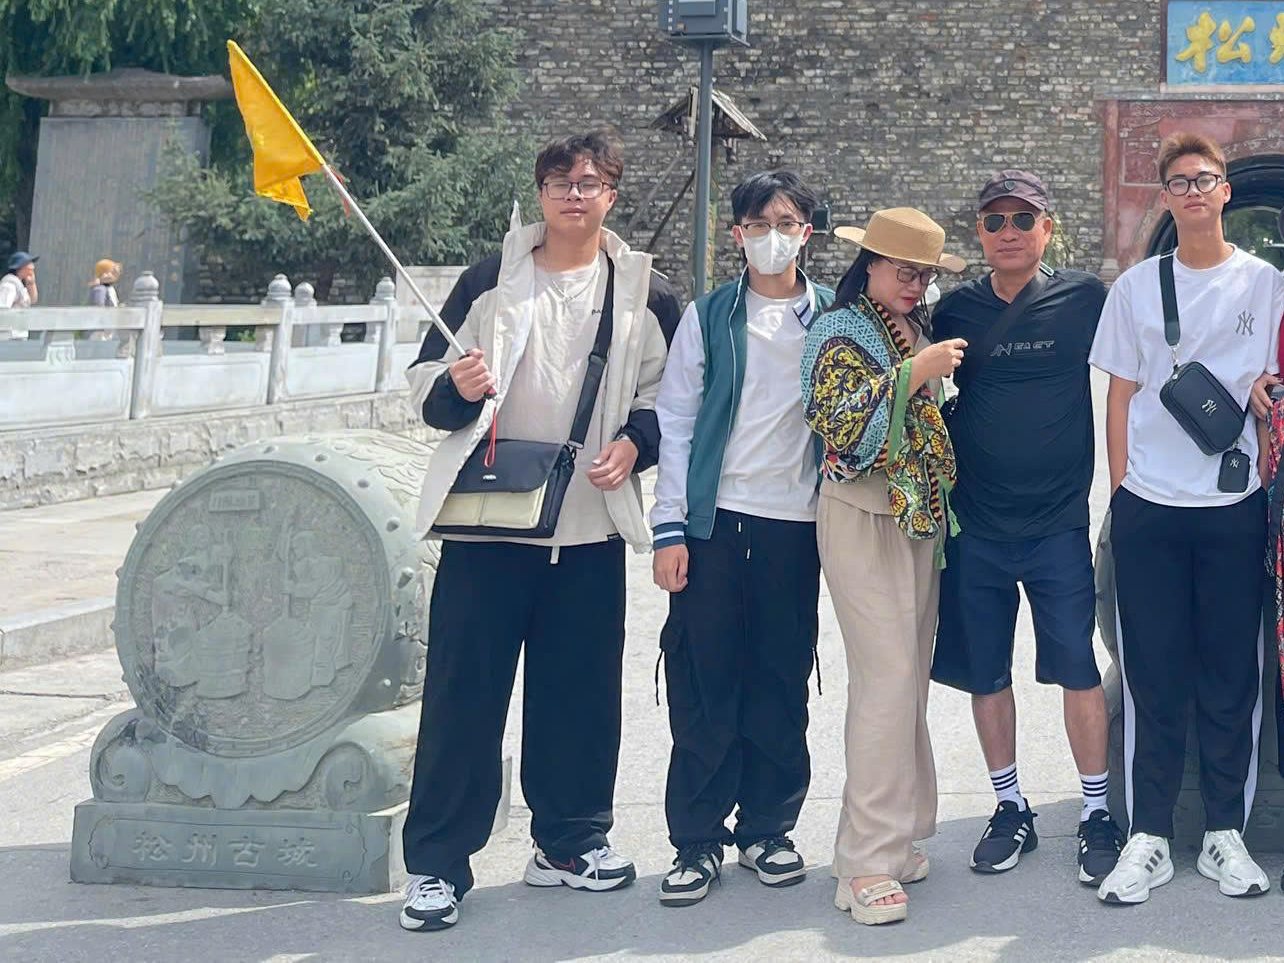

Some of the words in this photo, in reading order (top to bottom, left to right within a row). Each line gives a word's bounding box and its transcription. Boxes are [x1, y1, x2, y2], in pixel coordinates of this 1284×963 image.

[1235, 310, 1255, 336] NY
[131, 831, 318, 867] 松州古城
